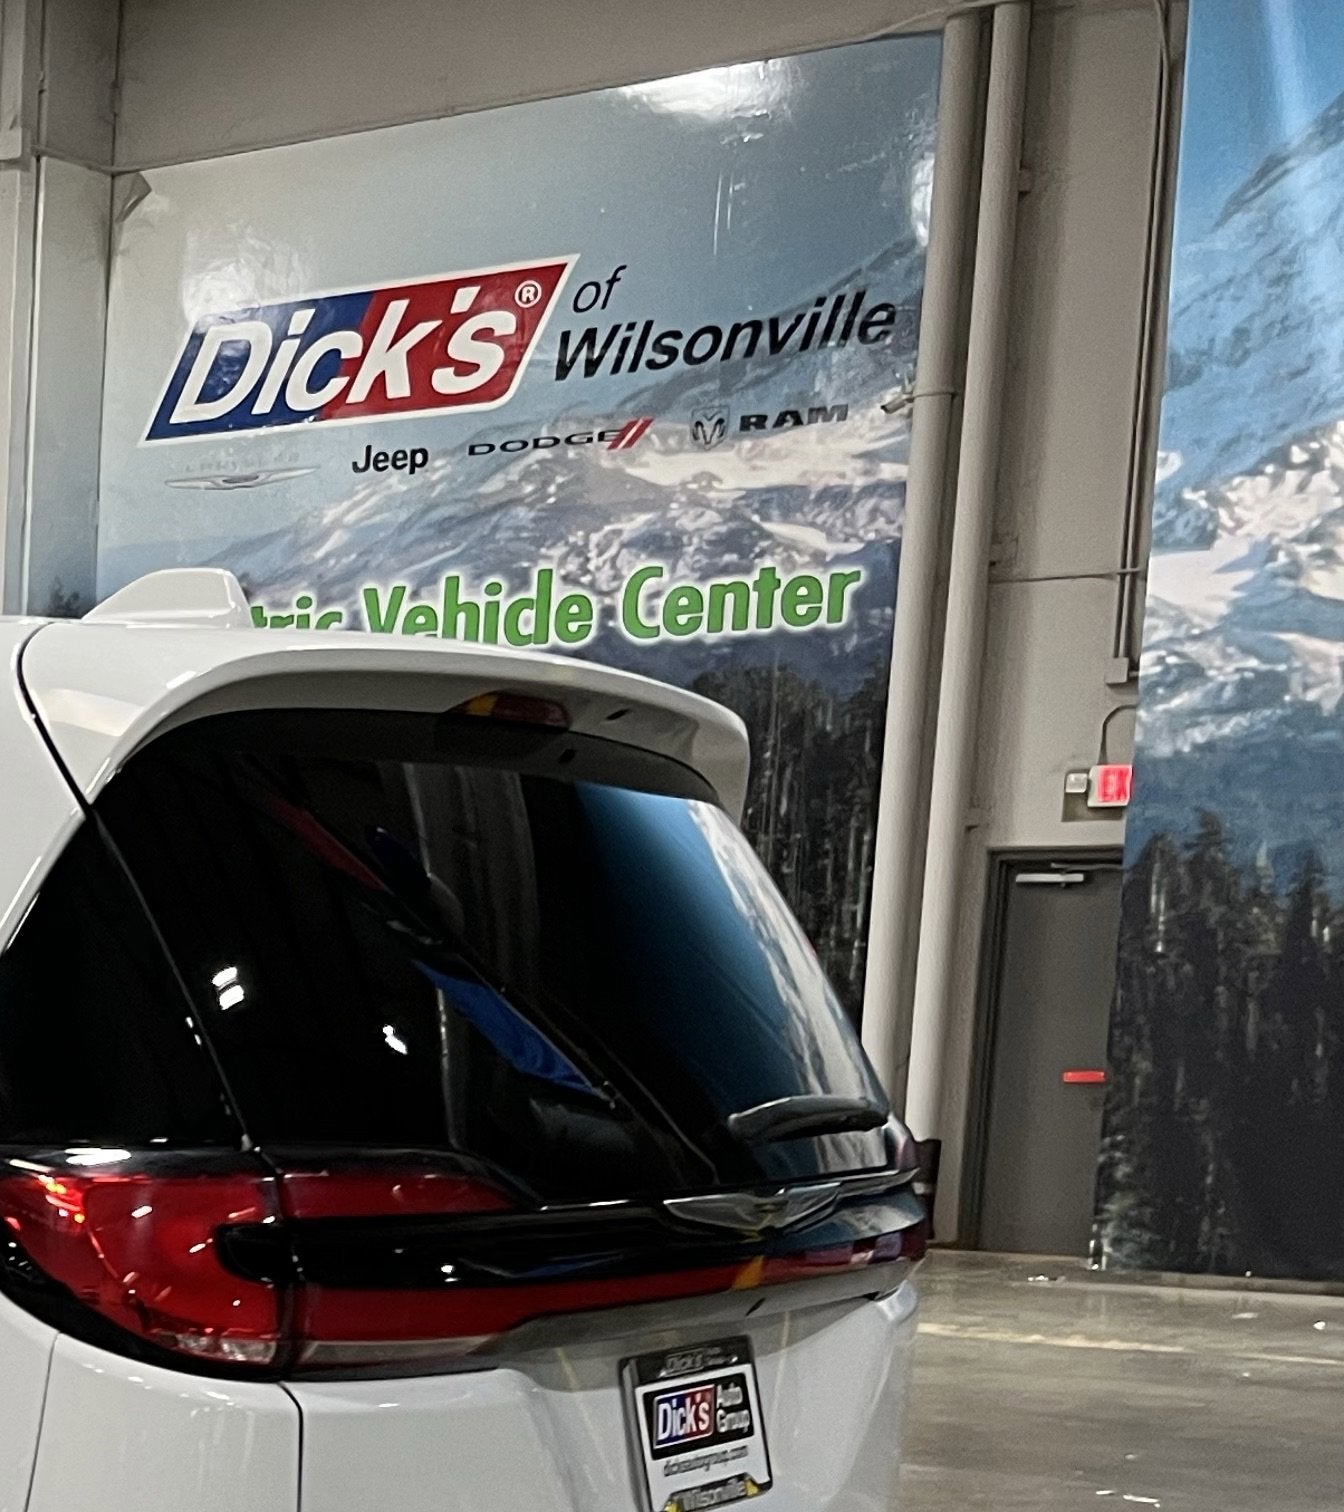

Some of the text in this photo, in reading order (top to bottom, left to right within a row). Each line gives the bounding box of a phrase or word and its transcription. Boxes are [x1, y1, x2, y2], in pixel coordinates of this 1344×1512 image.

[572, 265, 627, 313] of
[555, 290, 896, 381] Wilsonville
[739, 404, 849, 432] RAM
[352, 444, 429, 474] Jeep
[468, 429, 622, 456] DODGE
[364, 568, 593, 646] Vehicle
[622, 566, 861, 638] Center
[657, 1393, 710, 1441] Dick's
